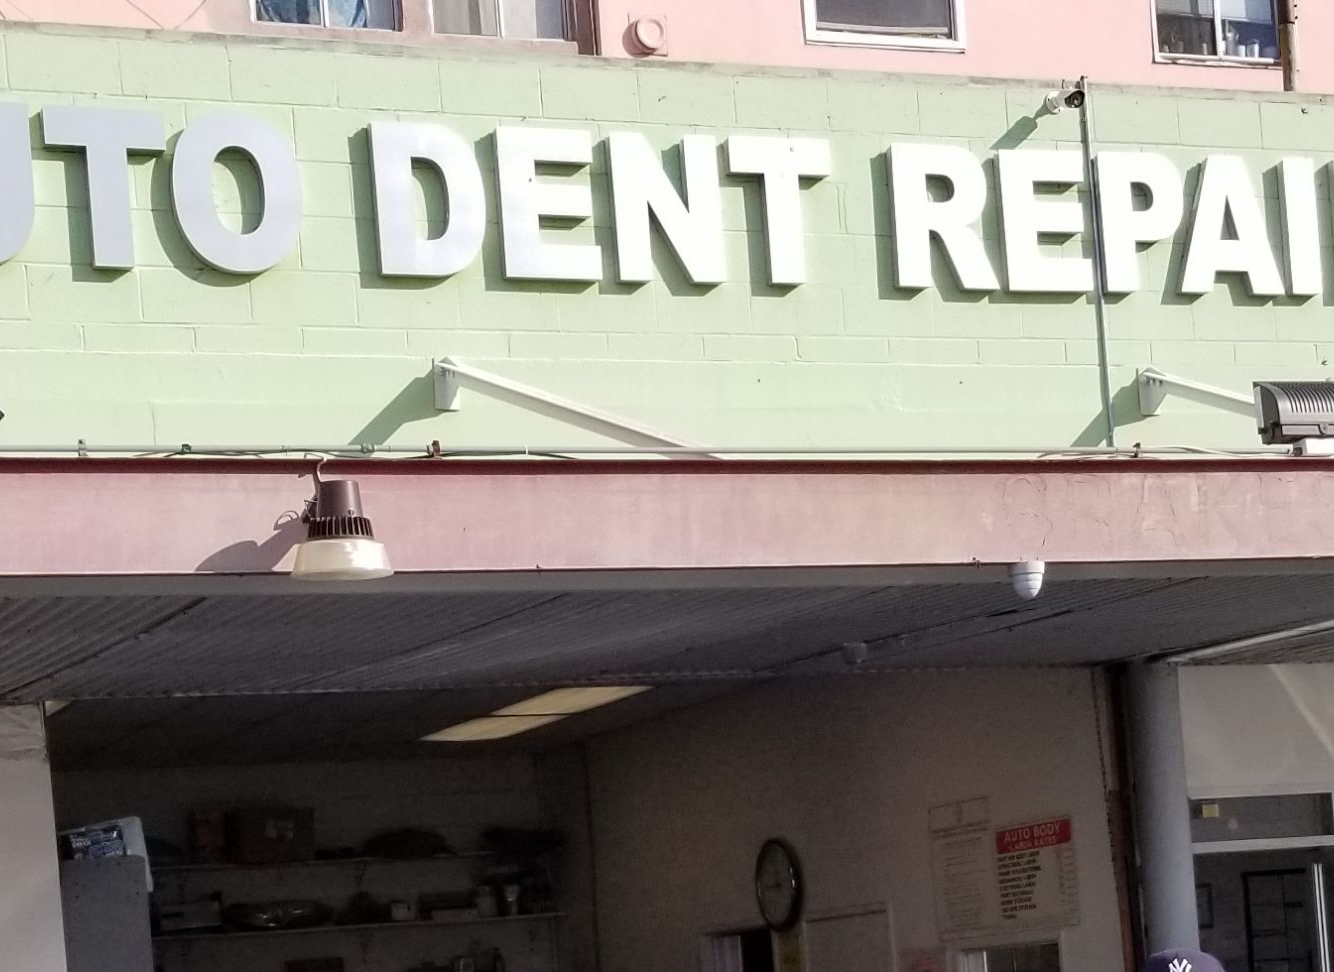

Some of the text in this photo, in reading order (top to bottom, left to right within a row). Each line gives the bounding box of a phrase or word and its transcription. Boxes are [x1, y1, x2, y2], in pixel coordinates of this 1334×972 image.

[370, 120, 831, 286] DENT
[1004, 822, 1061, 843] AUTO BODY
